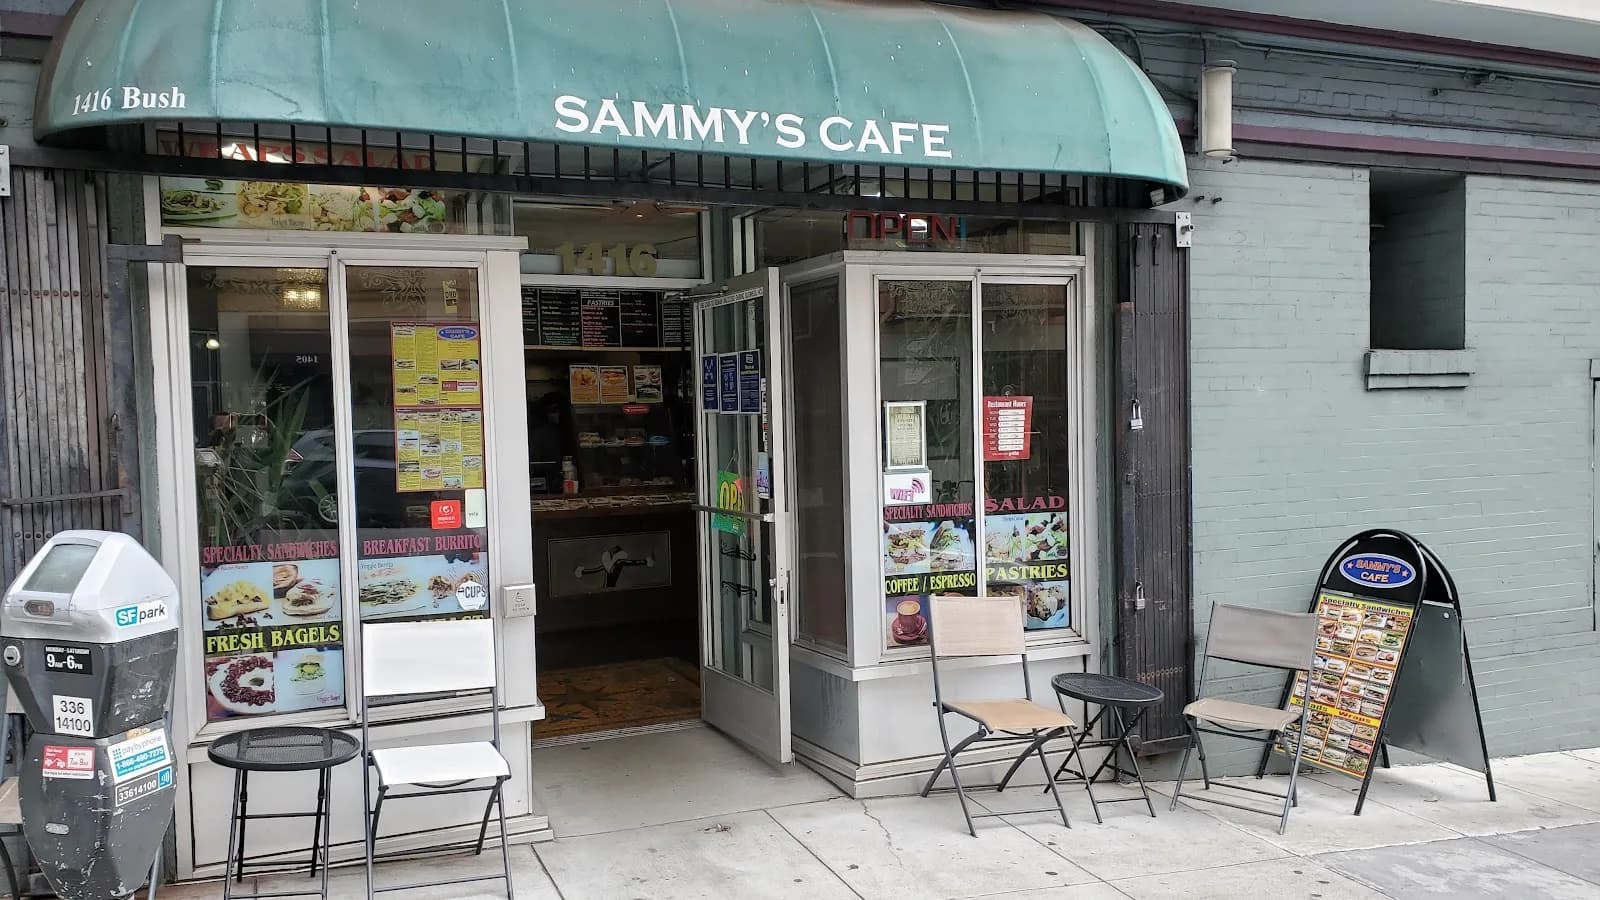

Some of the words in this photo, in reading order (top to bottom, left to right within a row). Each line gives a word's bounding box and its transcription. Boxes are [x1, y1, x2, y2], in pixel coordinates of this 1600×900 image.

[71, 87, 112, 116] 1416
[122, 85, 187, 110] Bush
[553, 94, 807, 149] SAMMY'S
[818, 115, 953, 159] CAFE
[560, 240, 658, 277] 1416
[884, 505, 923, 522] SPECIALTY
[926, 502, 973, 518] SANDWICHES
[984, 496, 1066, 512] SALAD
[203, 543, 261, 564] SPECIALTY
[266, 540, 337, 562] SANDWICHES
[363, 536, 431, 556] BREAKFAST
[434, 533, 482, 552] BURRITO
[985, 563, 1068, 581] PASTRIES
[1355, 559, 1402, 573] SAMMY'S
[885, 578, 920, 595] COFFEE
[929, 573, 976, 591] ESPRESSO
[1360, 571, 1390, 583] CAFE
[117, 609, 137, 625] SF
[139, 604, 166, 623] park
[206, 631, 264, 653] FRESH
[271, 624, 341, 648] BAGELS
[60, 700, 85, 715] 336
[55, 716, 91, 732] 14100
[118, 779, 157, 802] 33614100
